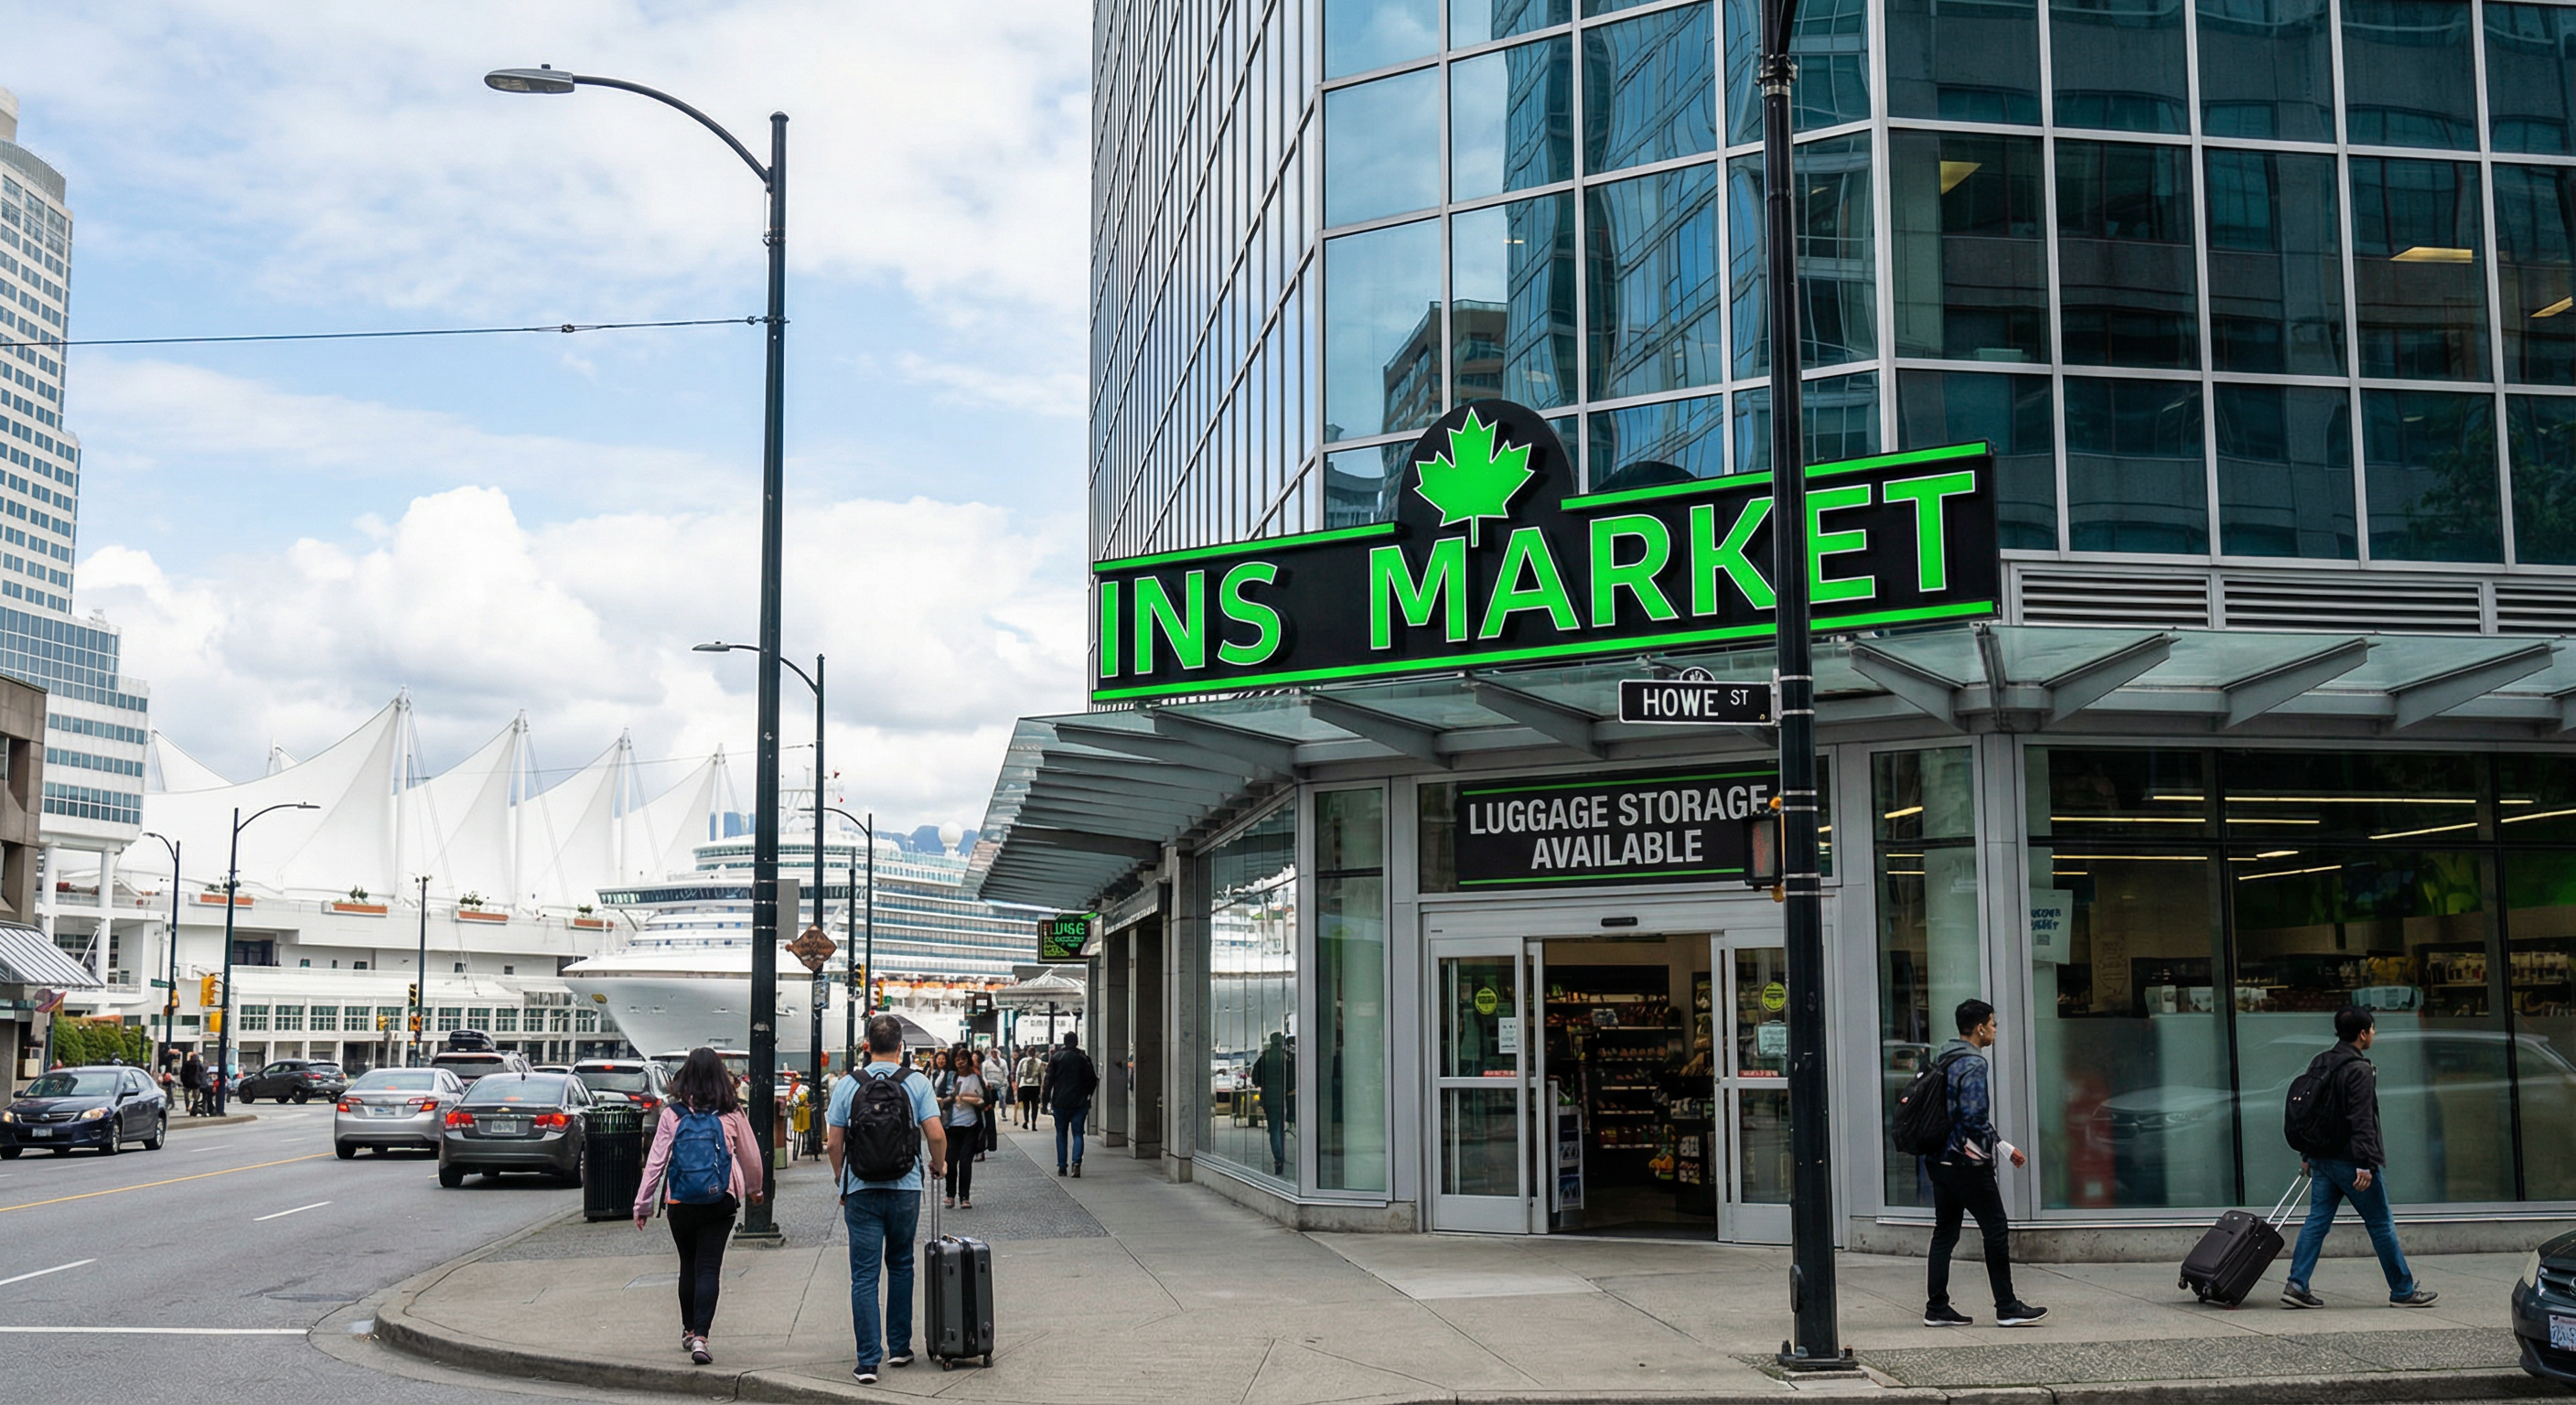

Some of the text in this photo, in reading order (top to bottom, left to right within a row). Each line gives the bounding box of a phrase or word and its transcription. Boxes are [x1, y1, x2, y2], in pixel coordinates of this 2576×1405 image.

[1100, 470, 1975, 678] INS MARKET
[1643, 688, 1749, 717] HOWE ST
[1470, 784, 1767, 834] LUGGAGE STORAGE
[1530, 830, 1703, 870] AVAILABLE
